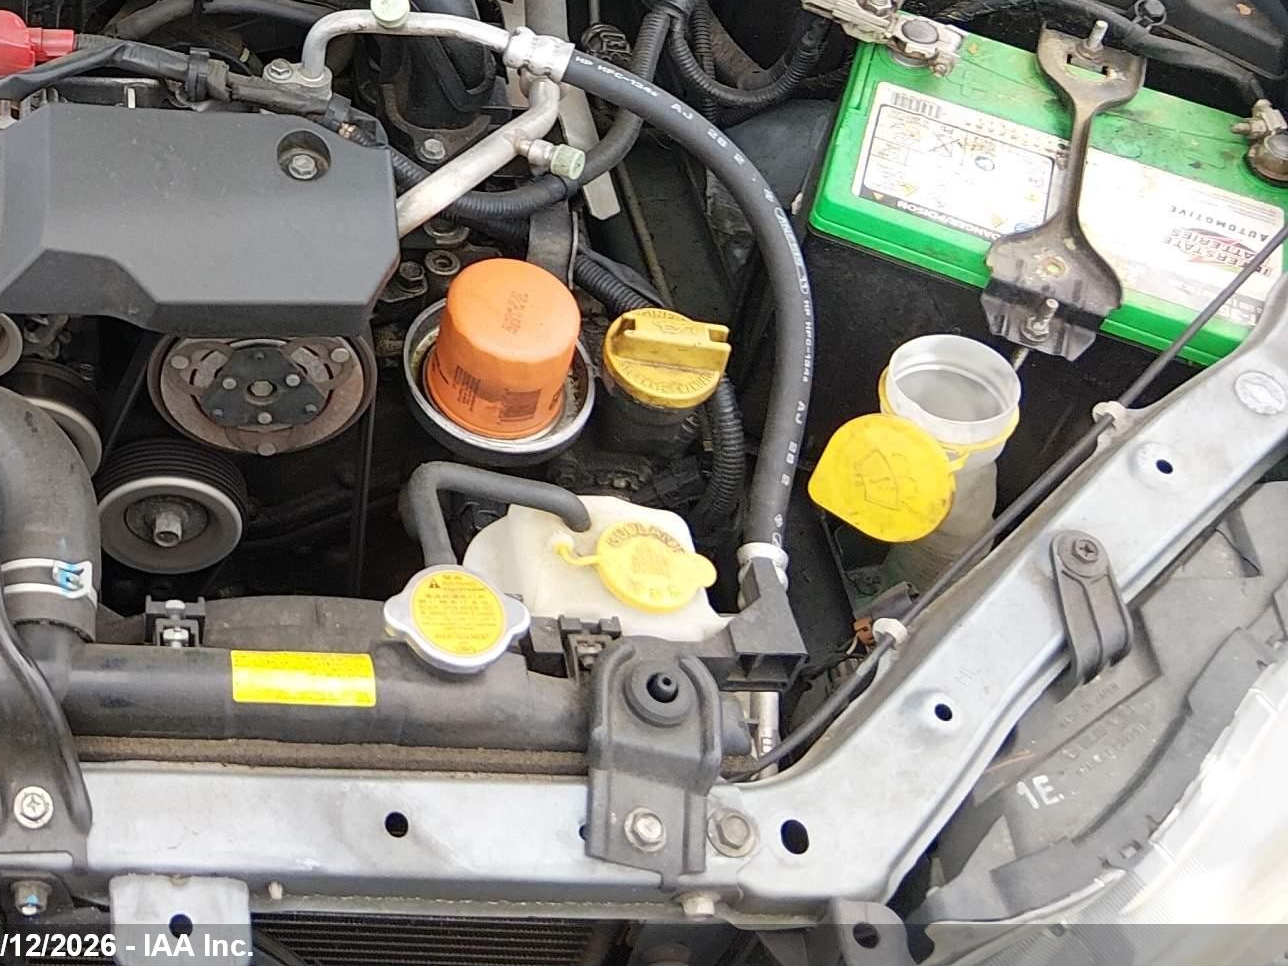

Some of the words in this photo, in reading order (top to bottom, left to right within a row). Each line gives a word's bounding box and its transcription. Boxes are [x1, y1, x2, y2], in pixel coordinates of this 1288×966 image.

[671, 103, 694, 120] AJ
[1167, 204, 1270, 243] AUTOMOTIVE
[1171, 227, 1257, 260] ATTERIES
[794, 400, 807, 425] AJ
[1015, 774, 1061, 810] 1E
